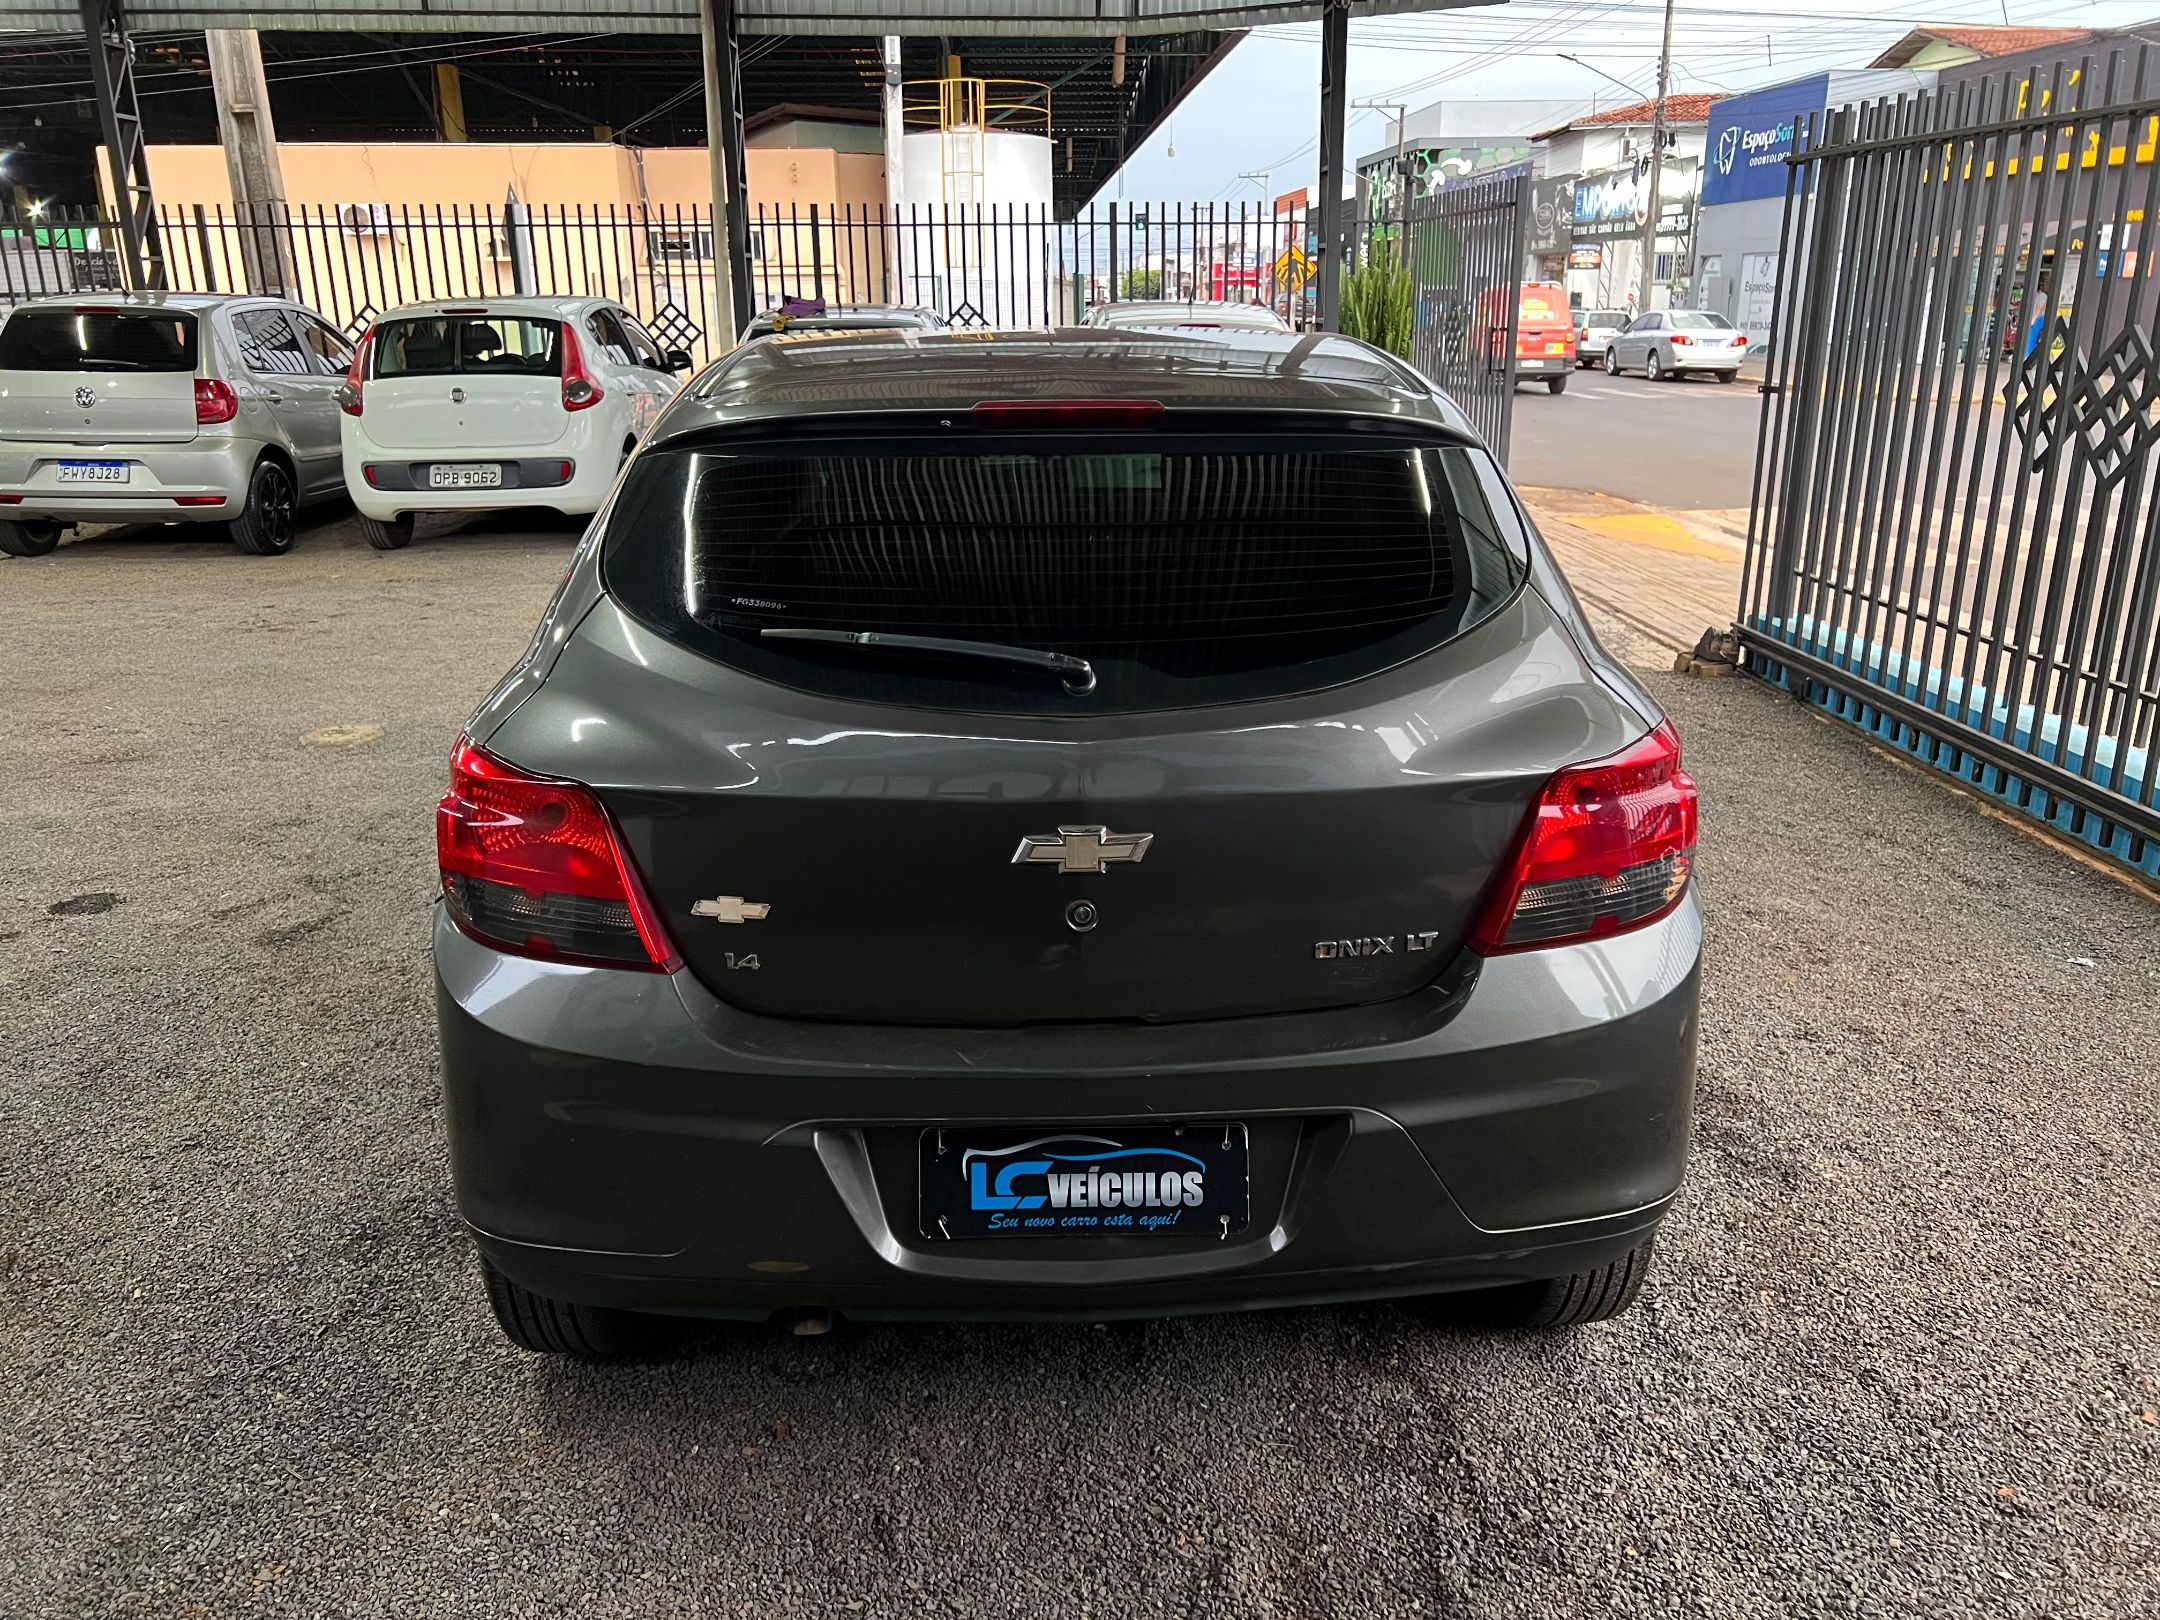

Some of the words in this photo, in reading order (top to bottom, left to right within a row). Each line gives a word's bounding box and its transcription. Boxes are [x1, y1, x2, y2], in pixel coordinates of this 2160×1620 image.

[1749, 151, 1791, 167] ODONTOLO
[464, 472, 497, 484] 9062
[1315, 936, 1395, 959] ONIX
[1407, 931, 1439, 952] LT
[1047, 1165, 1204, 1208] VEÍCULOS
[988, 1213, 1019, 1229] Seu
[1024, 1218, 1055, 1227] novo
[1061, 1216, 1098, 1226] carro
[1104, 1213, 1134, 1226] esta
[1139, 1210, 1181, 1231] aqui!
